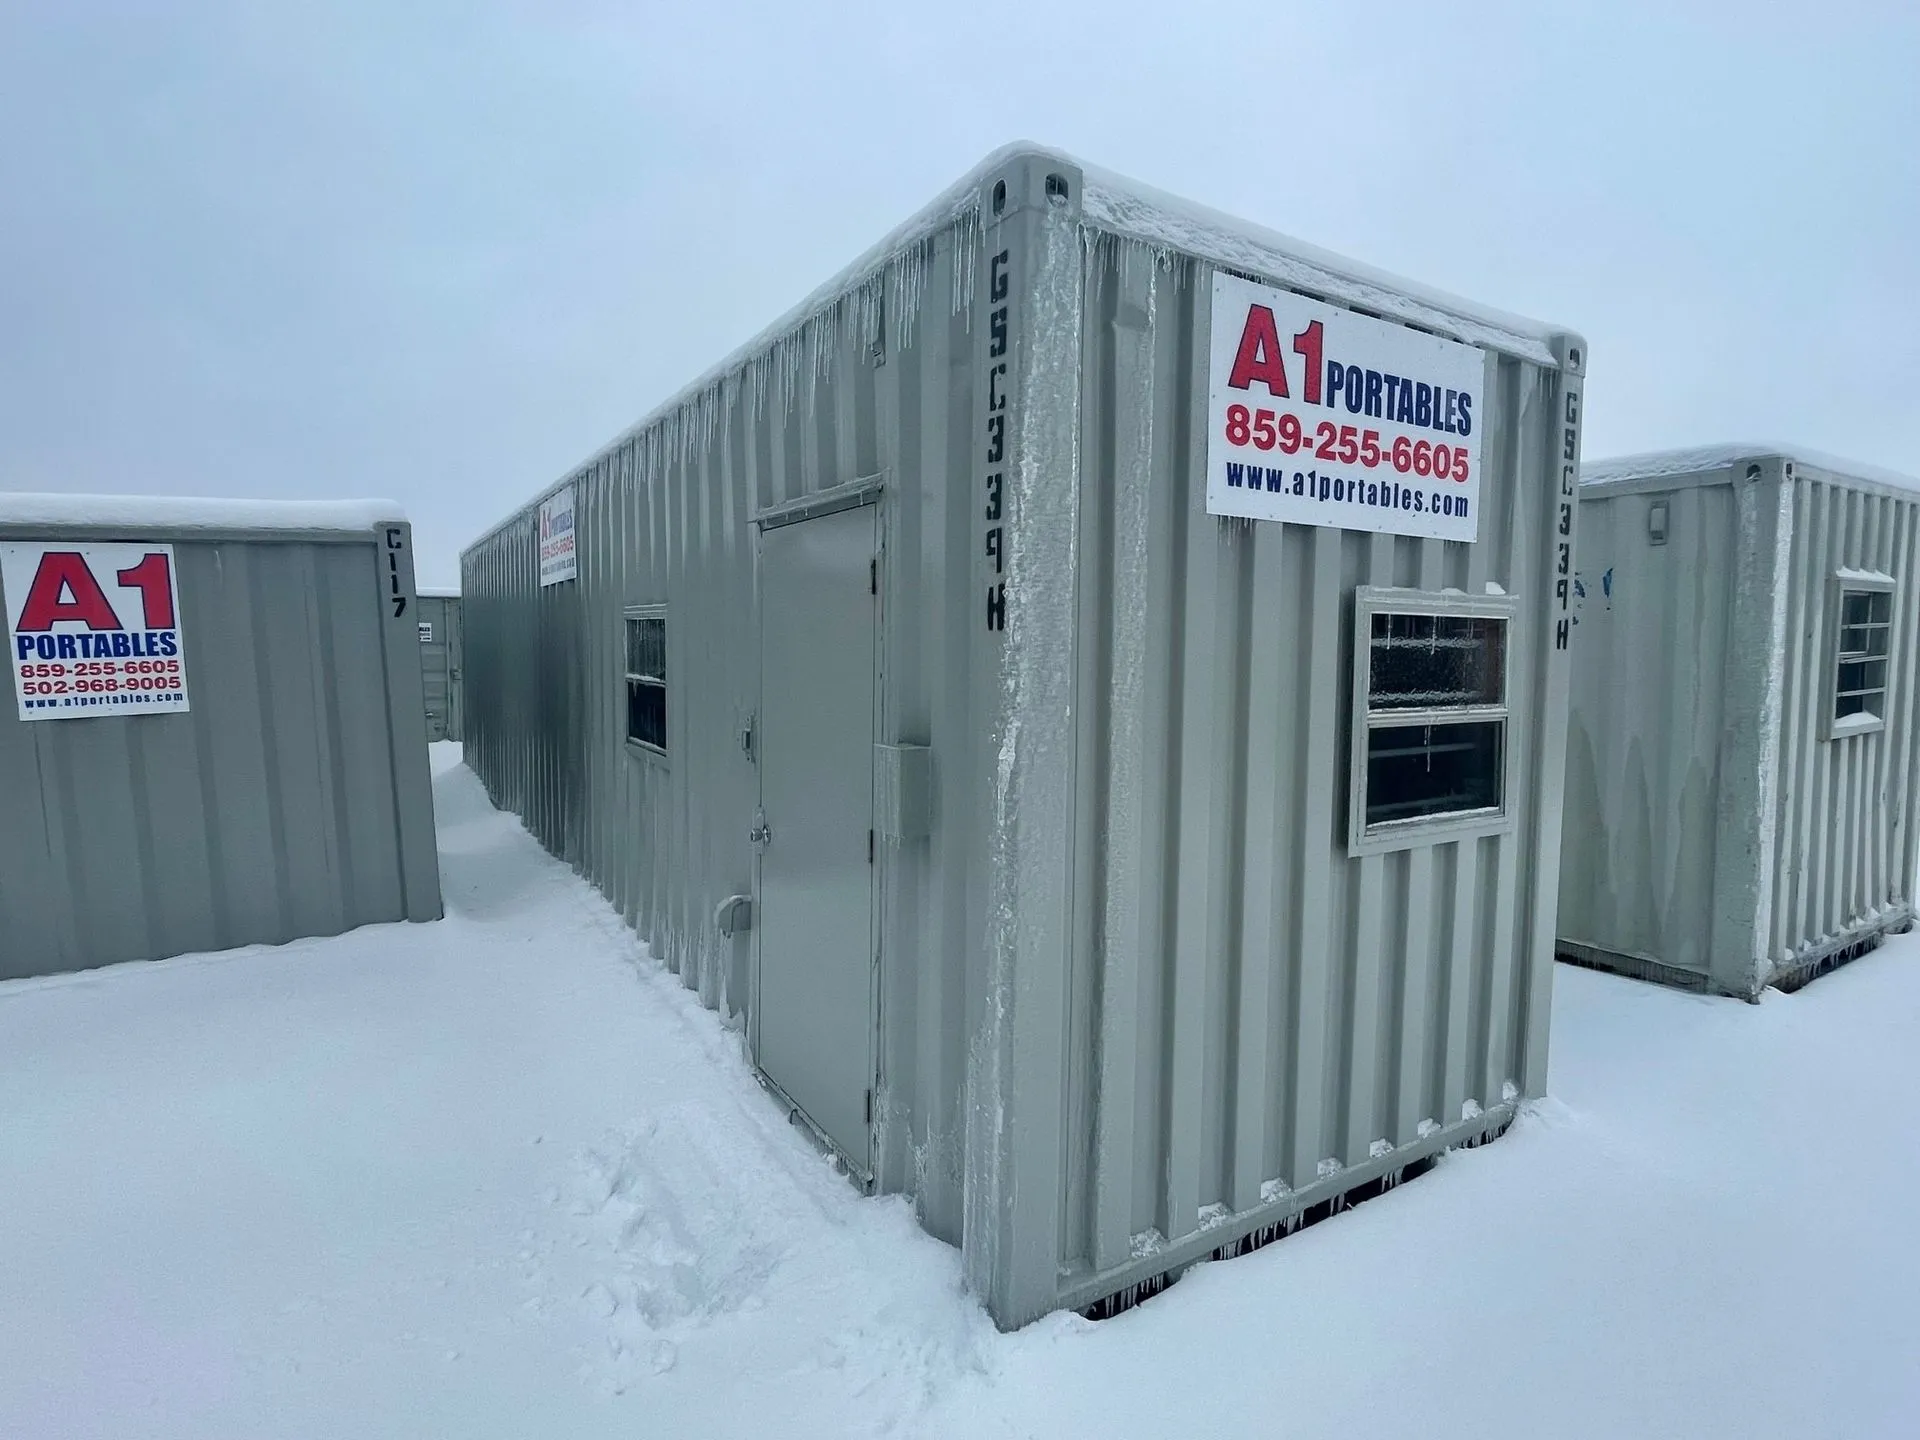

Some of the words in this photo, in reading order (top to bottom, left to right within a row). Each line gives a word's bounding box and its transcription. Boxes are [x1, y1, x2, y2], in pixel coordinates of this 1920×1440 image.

[1228, 303, 1324, 405] A1
[1326, 360, 1472, 437] PORTABLES
[986, 249, 1009, 632] GSC339H
[1225, 404, 1469, 483] 859-255-6605
[1226, 462, 1469, 517] www.a1portables.com
[1556, 391, 1577, 650] GSC339H
[16, 552, 175, 632] A1
[17, 632, 178, 660] PORTABLES
[20, 660, 180, 679] 859-255-6605
[23, 676, 182, 695] 502-968-9005
[25, 692, 184, 709] www.a1portables.com
